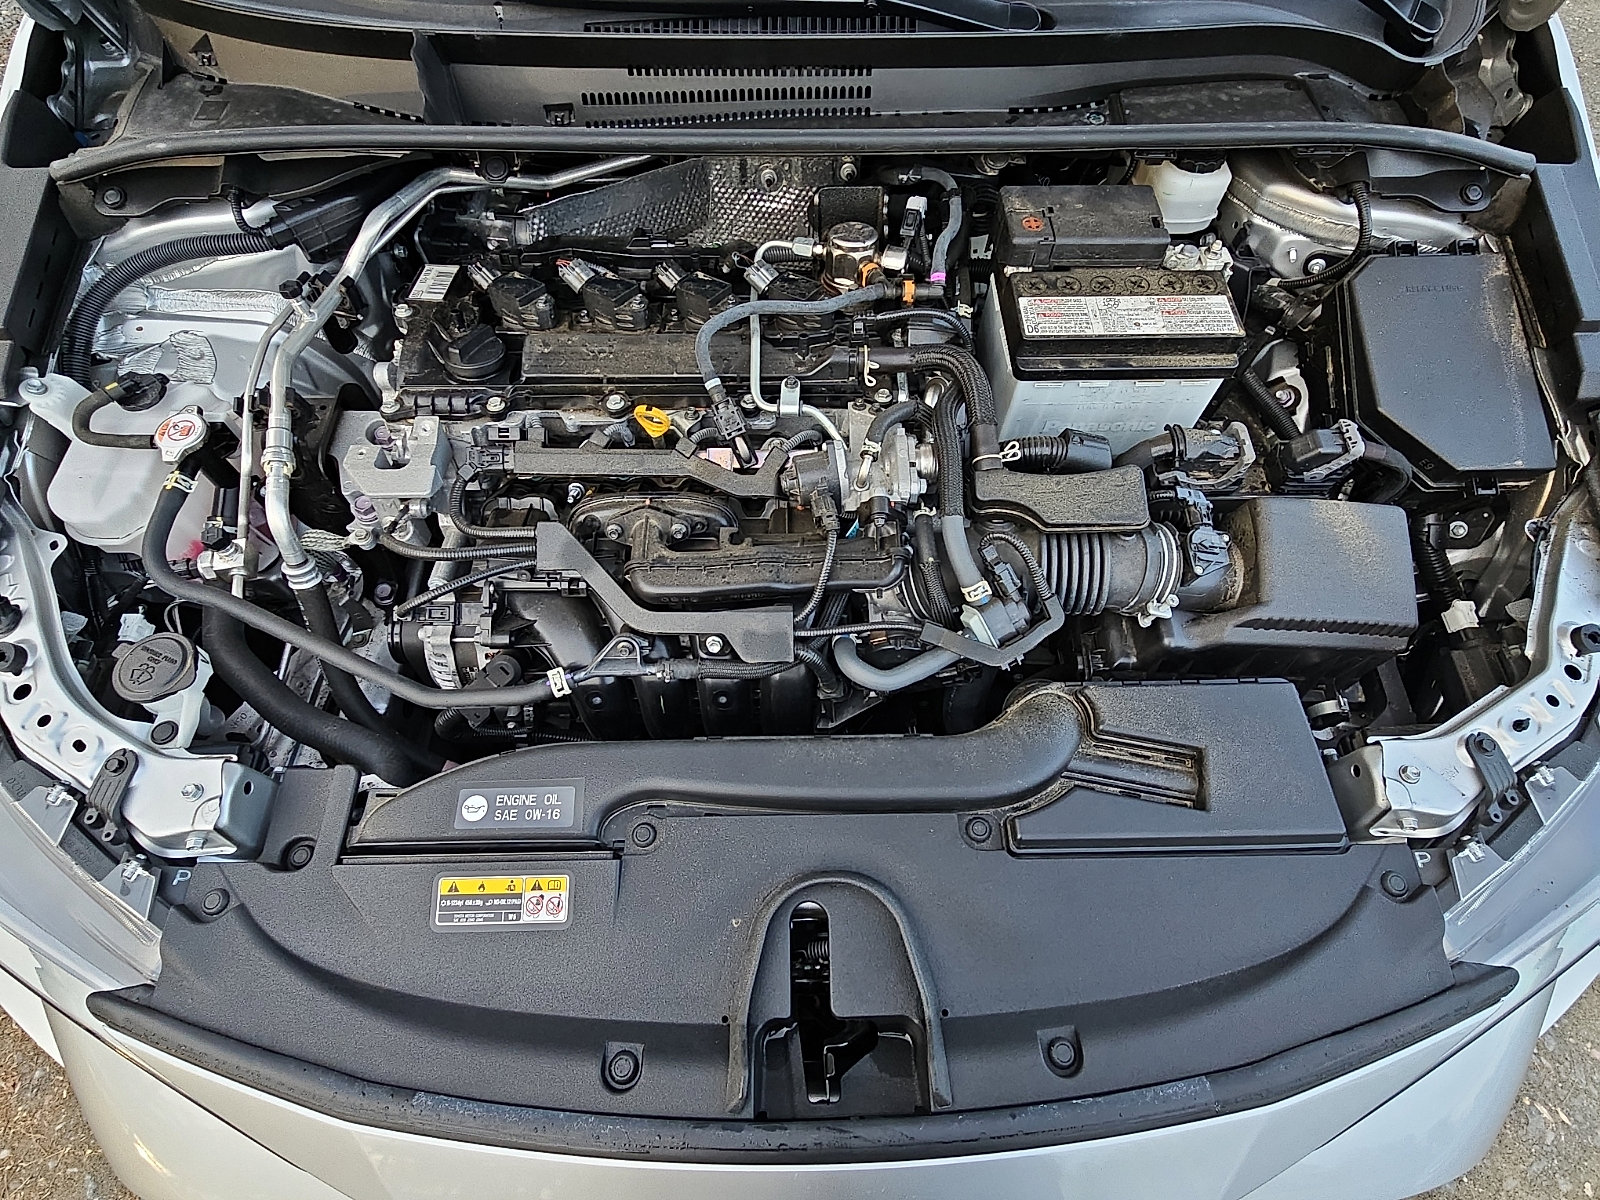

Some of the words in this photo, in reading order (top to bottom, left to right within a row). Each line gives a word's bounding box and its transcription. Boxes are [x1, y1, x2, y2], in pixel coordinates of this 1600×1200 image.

[495, 794, 537, 806] ENGINE
[544, 793, 562, 805] OIL
[494, 809, 518, 821] SAE
[1414, 851, 1431, 868] P
[172, 869, 192, 886] P
